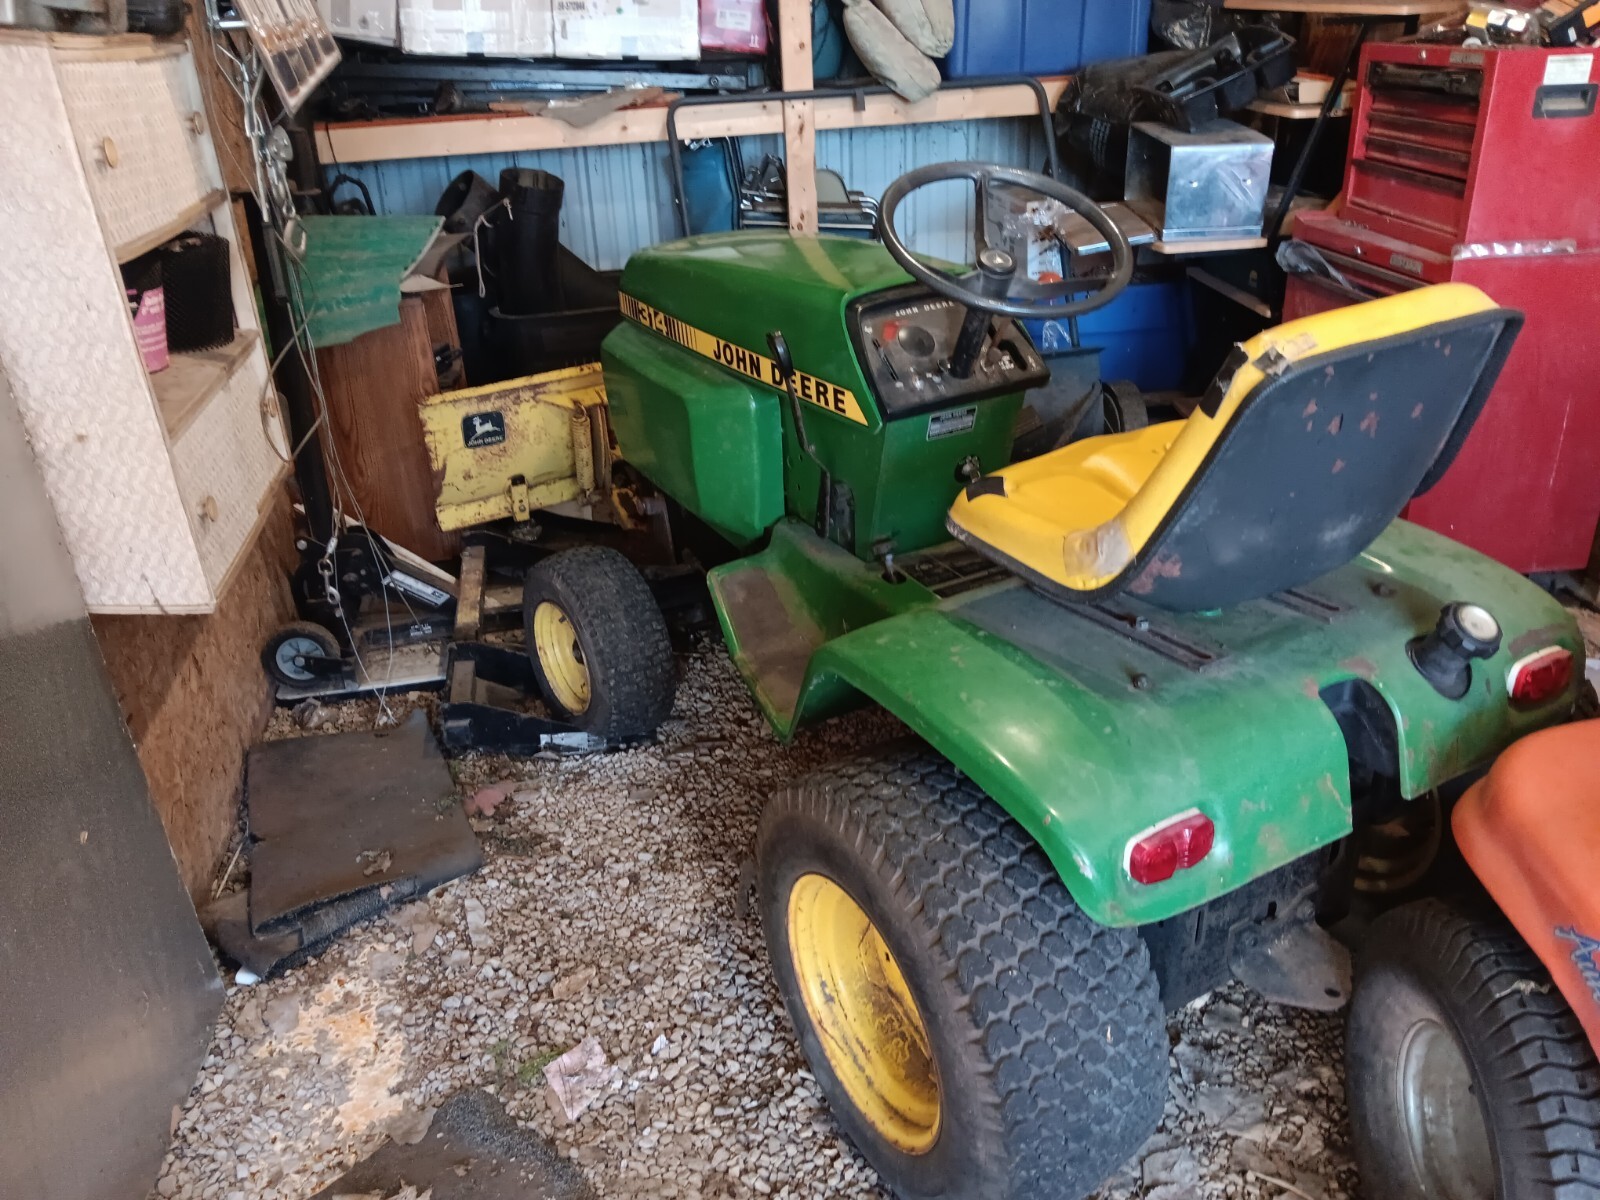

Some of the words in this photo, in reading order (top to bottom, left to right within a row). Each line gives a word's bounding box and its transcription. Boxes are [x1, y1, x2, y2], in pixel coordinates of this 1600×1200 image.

[895, 306, 919, 317] JOHN
[923, 300, 954, 312] DEERE
[638, 301, 668, 336] 314
[713, 339, 762, 378] JOHN
